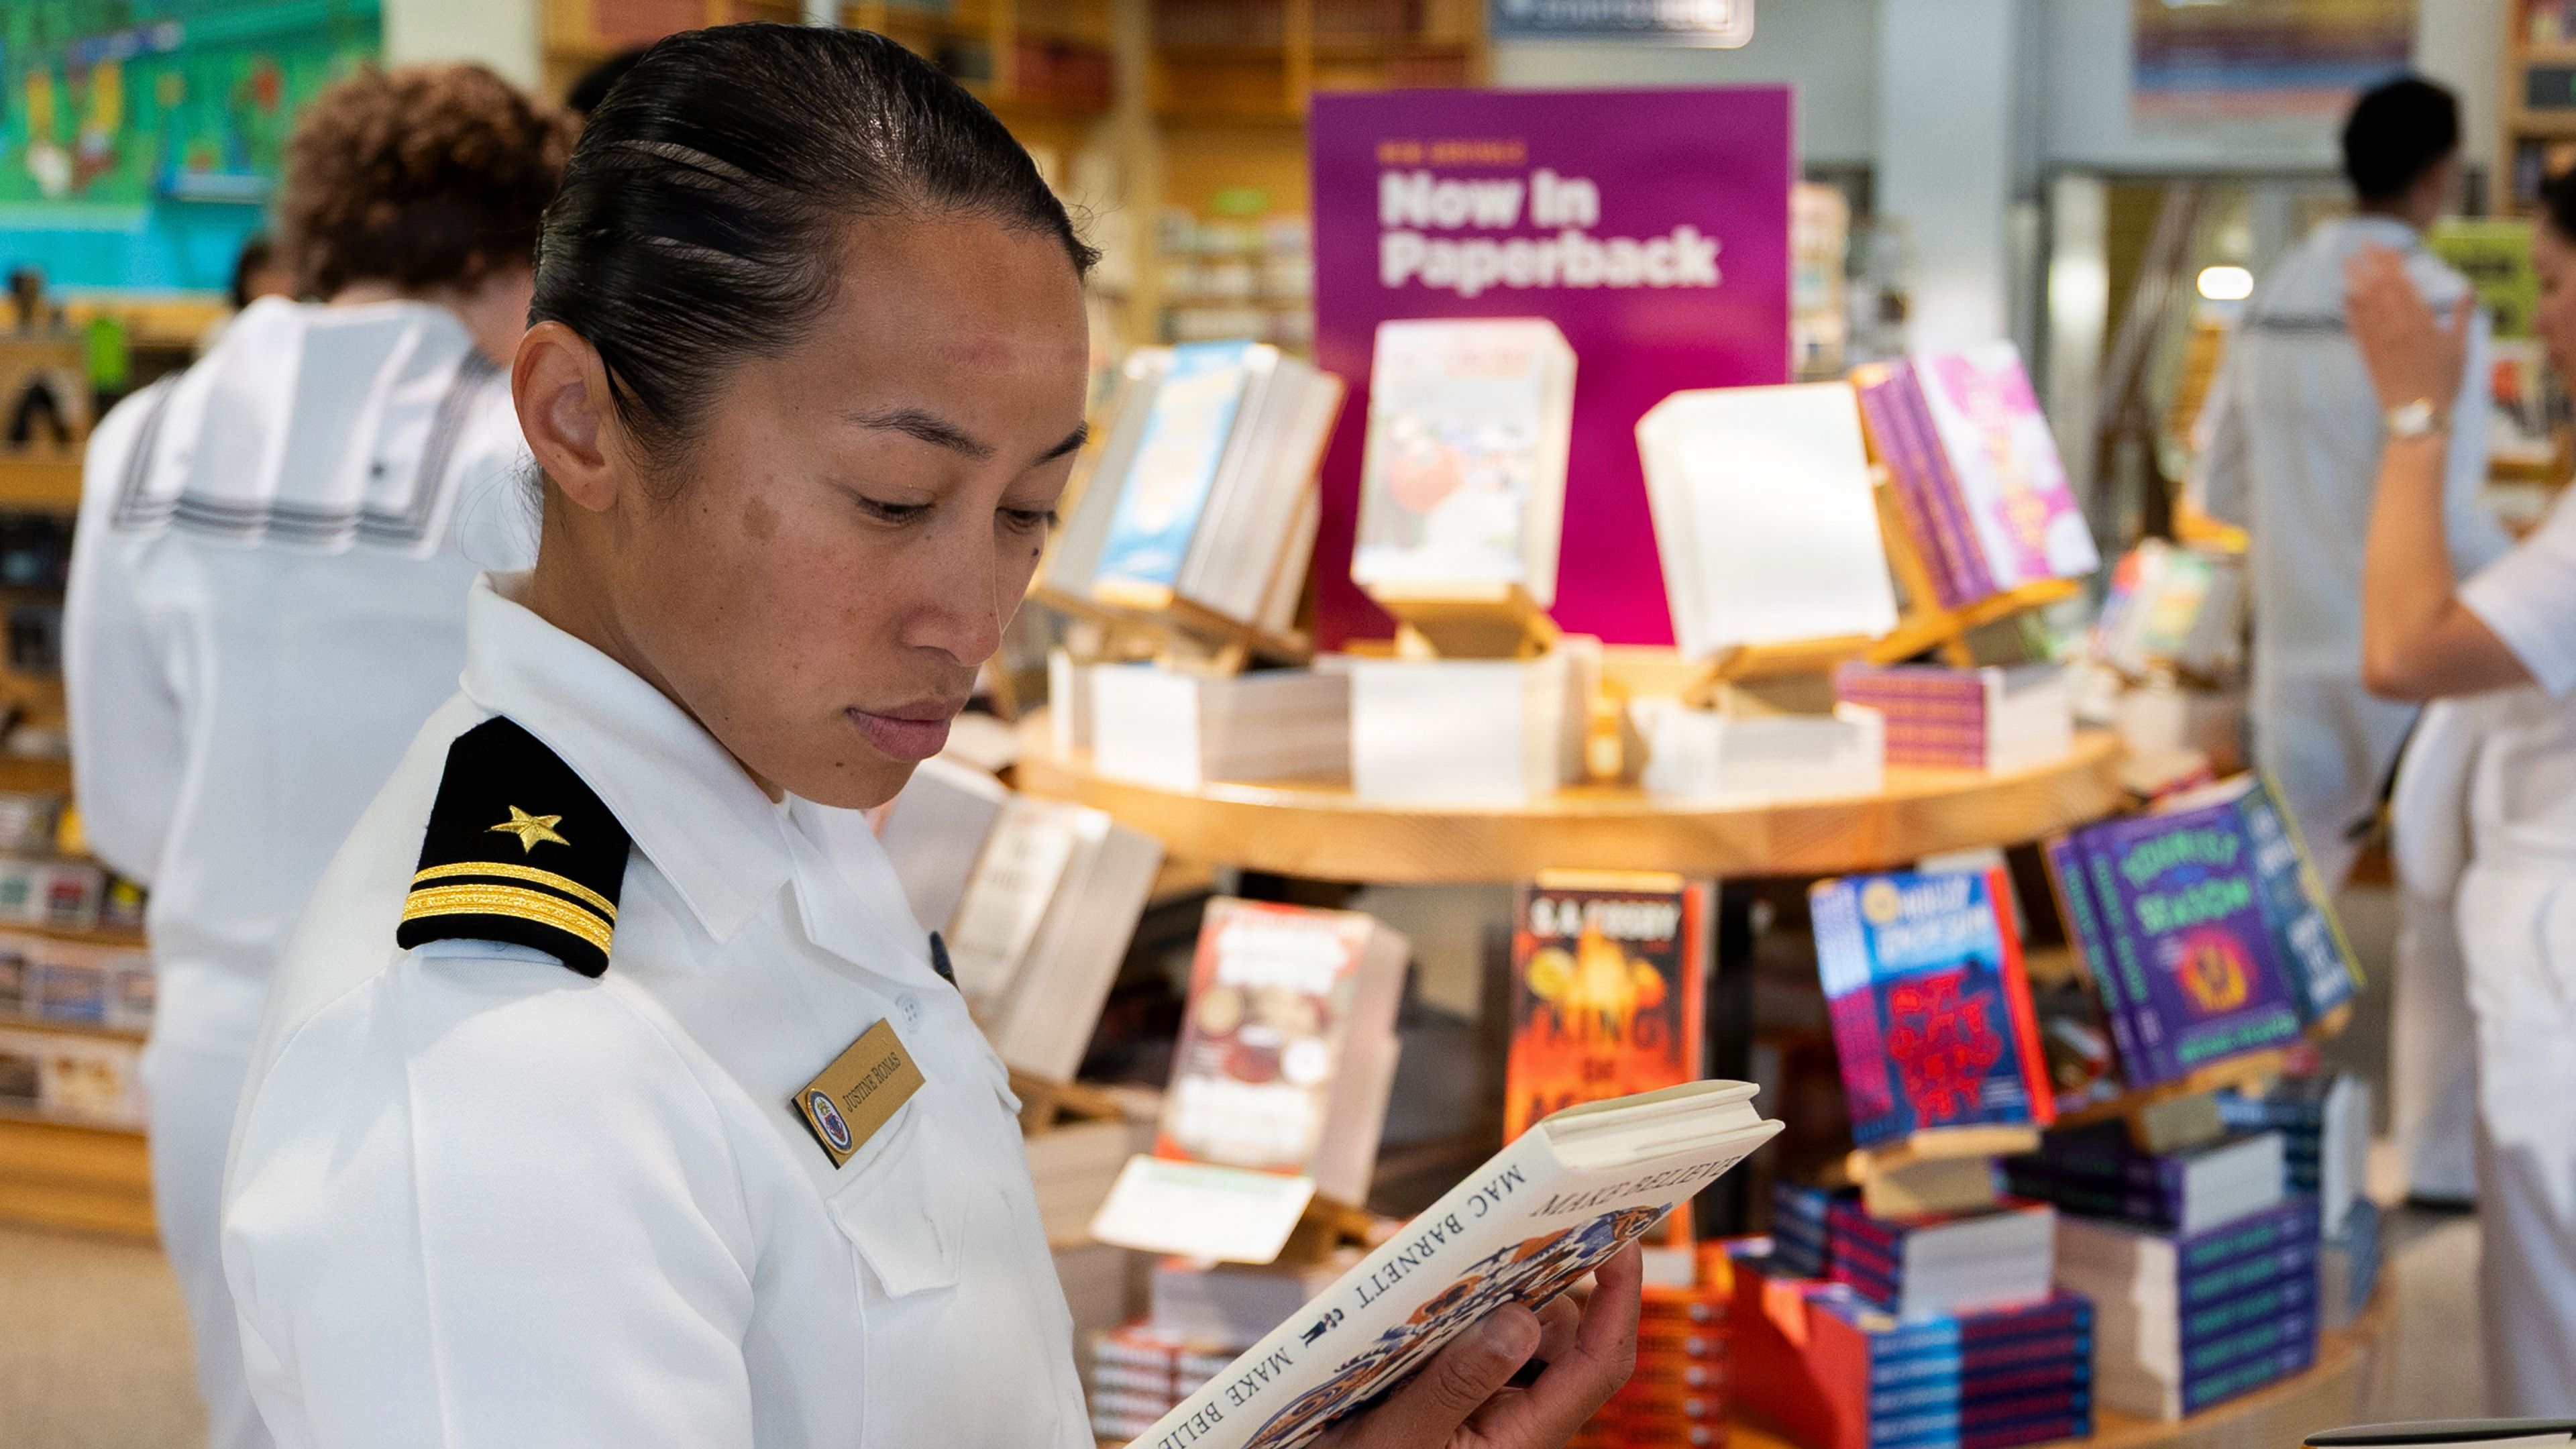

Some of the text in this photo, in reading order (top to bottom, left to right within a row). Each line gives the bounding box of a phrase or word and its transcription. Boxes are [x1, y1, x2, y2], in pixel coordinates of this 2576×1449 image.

[1380, 169, 1600, 228] Now In
[1379, 226, 1720, 297] Paperback
[2136, 878, 2251, 933] SEASON
[843, 1074, 877, 1112] JUSTINE
[1529, 1155, 1743, 1217] MAKE BELIEVE
[1356, 1165, 1525, 1309] MAC BARNETT
[1225, 1347, 1293, 1407] MAKE
